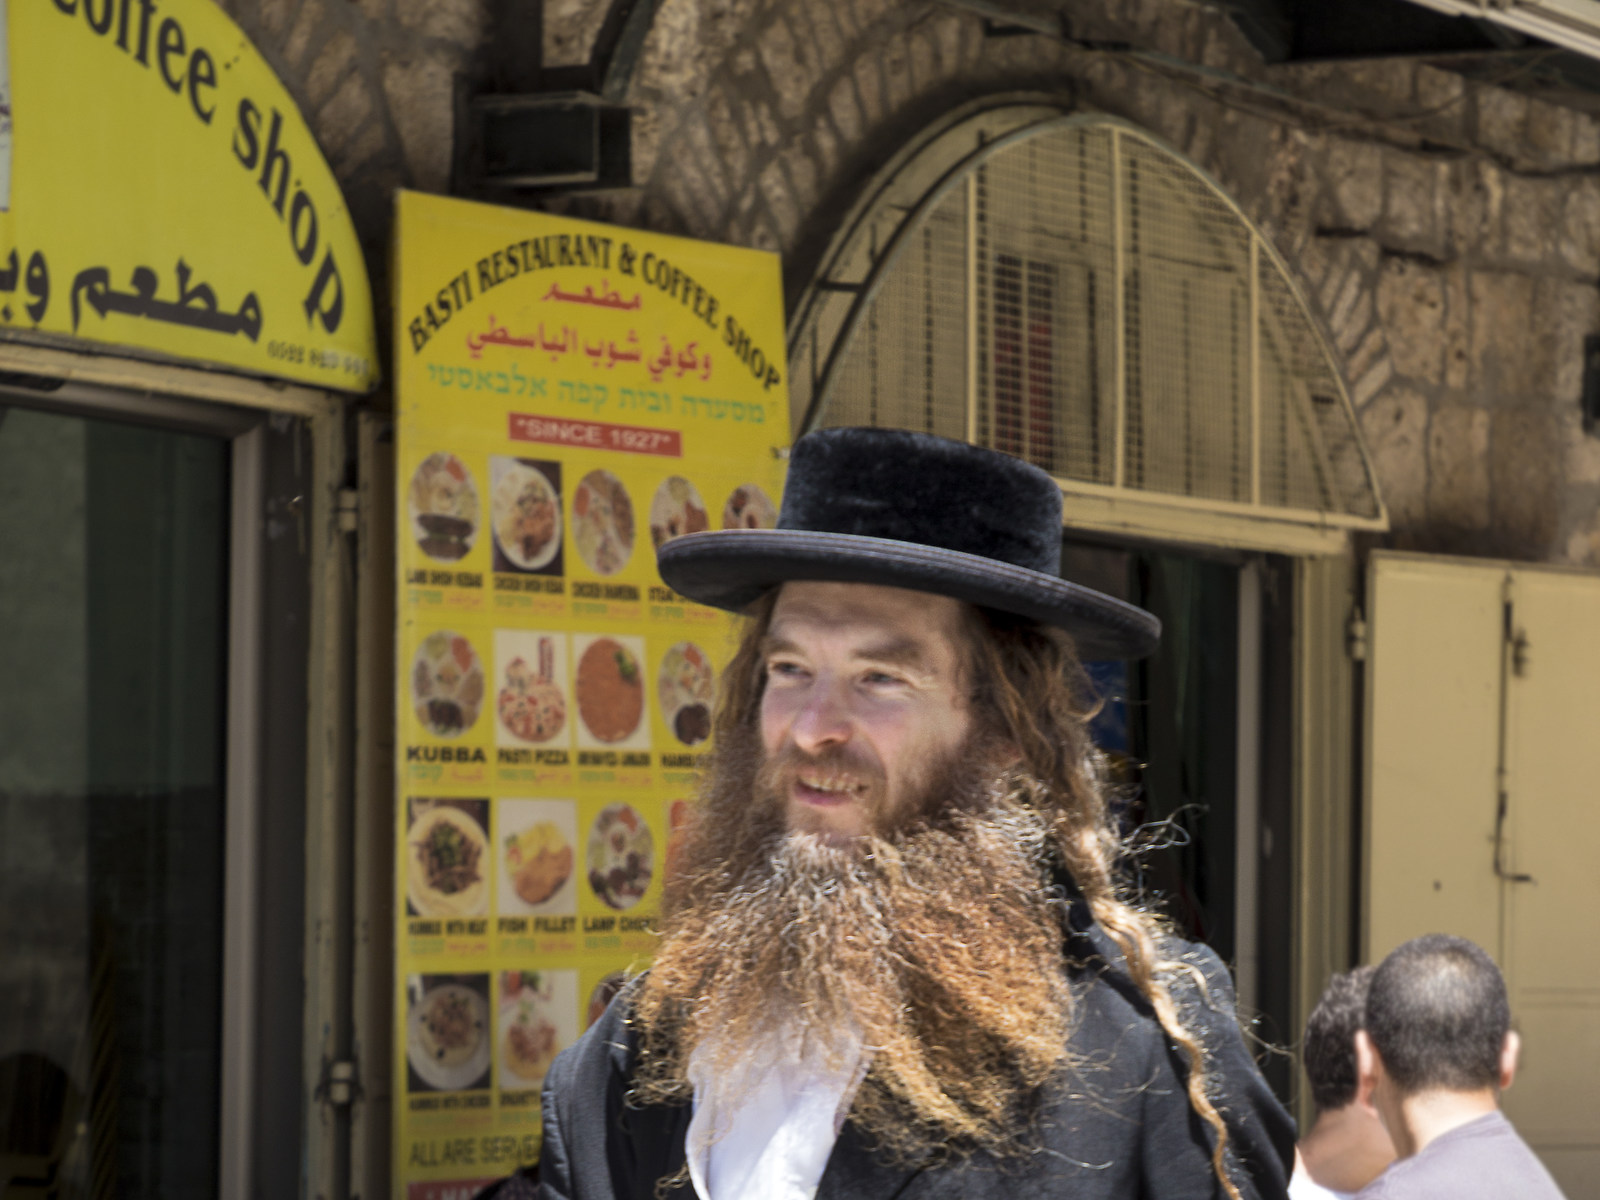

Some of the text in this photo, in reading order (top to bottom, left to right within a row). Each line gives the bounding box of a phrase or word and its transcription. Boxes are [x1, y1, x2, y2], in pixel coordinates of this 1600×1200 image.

[232, 98, 344, 334] shop
[71, 257, 263, 343] مطعم
[408, 234, 781, 391] BASTI RESTAURANT & COFFEE SHOP
[541, 280, 642, 310] مطعم
[466, 313, 580, 361] الباسطي
[583, 328, 641, 369] شوب
[558, 379, 608, 414] קפה
[406, 746, 487, 763] KUBBA
[534, 915, 577, 933] FILLET
[408, 1133, 541, 1168] ALL ARE SERVE
